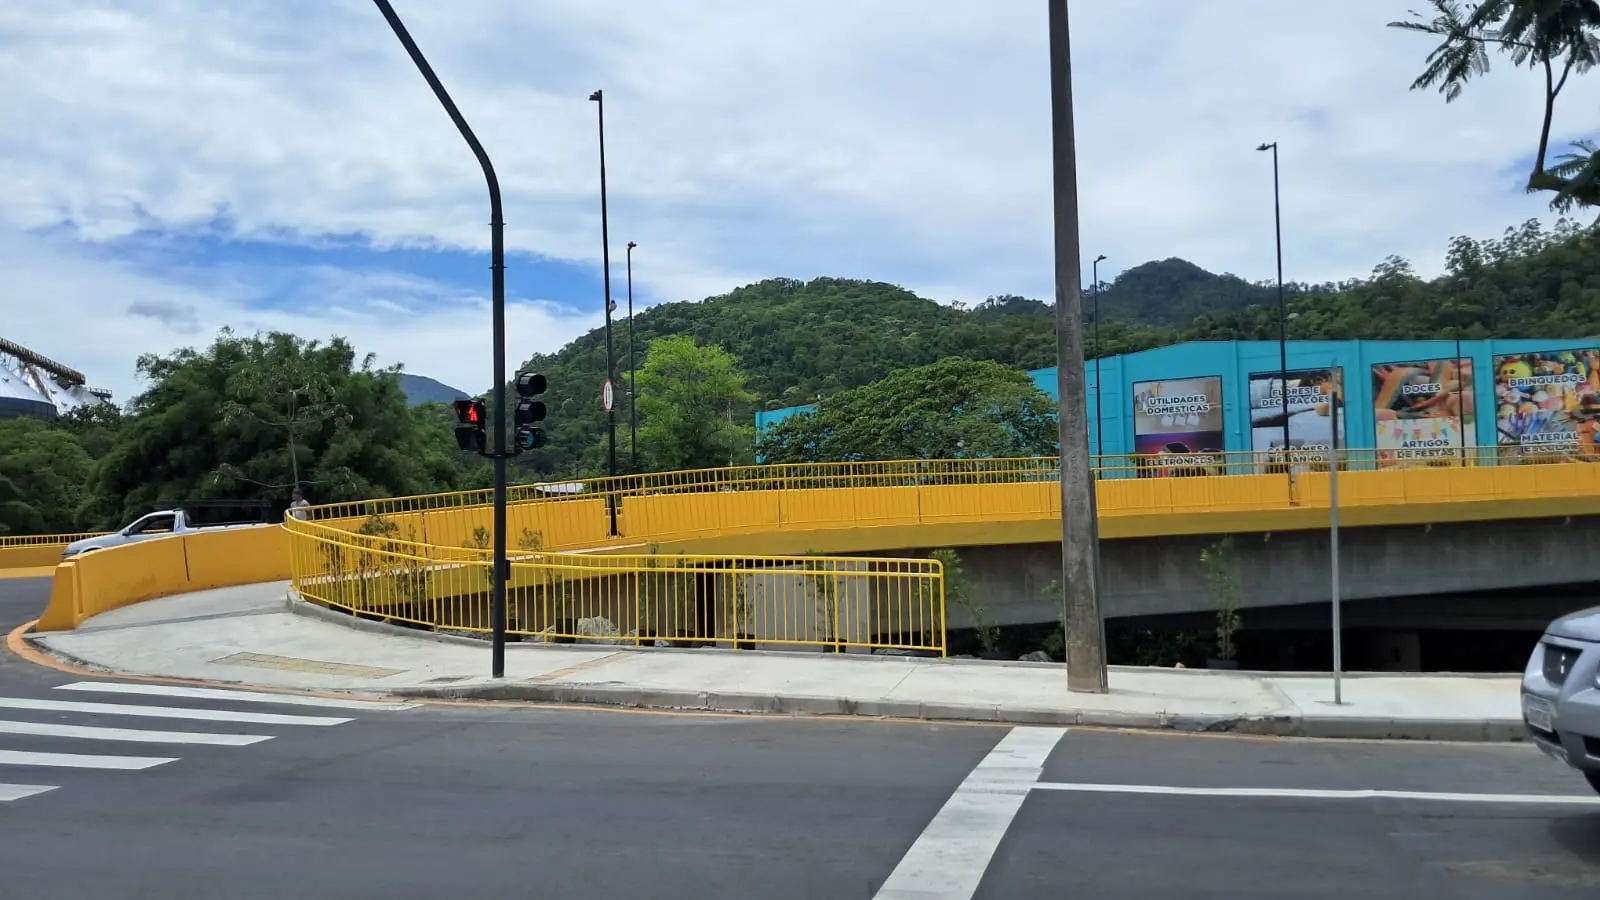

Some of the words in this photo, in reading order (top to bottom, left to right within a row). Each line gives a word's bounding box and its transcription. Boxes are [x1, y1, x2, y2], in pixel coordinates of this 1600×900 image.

[1509, 374, 1586, 387] BRINQUEDOS
[1313, 386, 1320, 394] E
[1404, 383, 1441, 394] DOCES
[1149, 395, 1206, 406] UTILIDADES
[1147, 404, 1209, 415] DOMESTICAS
[1522, 432, 1580, 442] MATERIAL
[1402, 439, 1450, 449] ARTIGOS
[1397, 450, 1413, 459] DE
[1415, 448, 1455, 458] FESTAS
